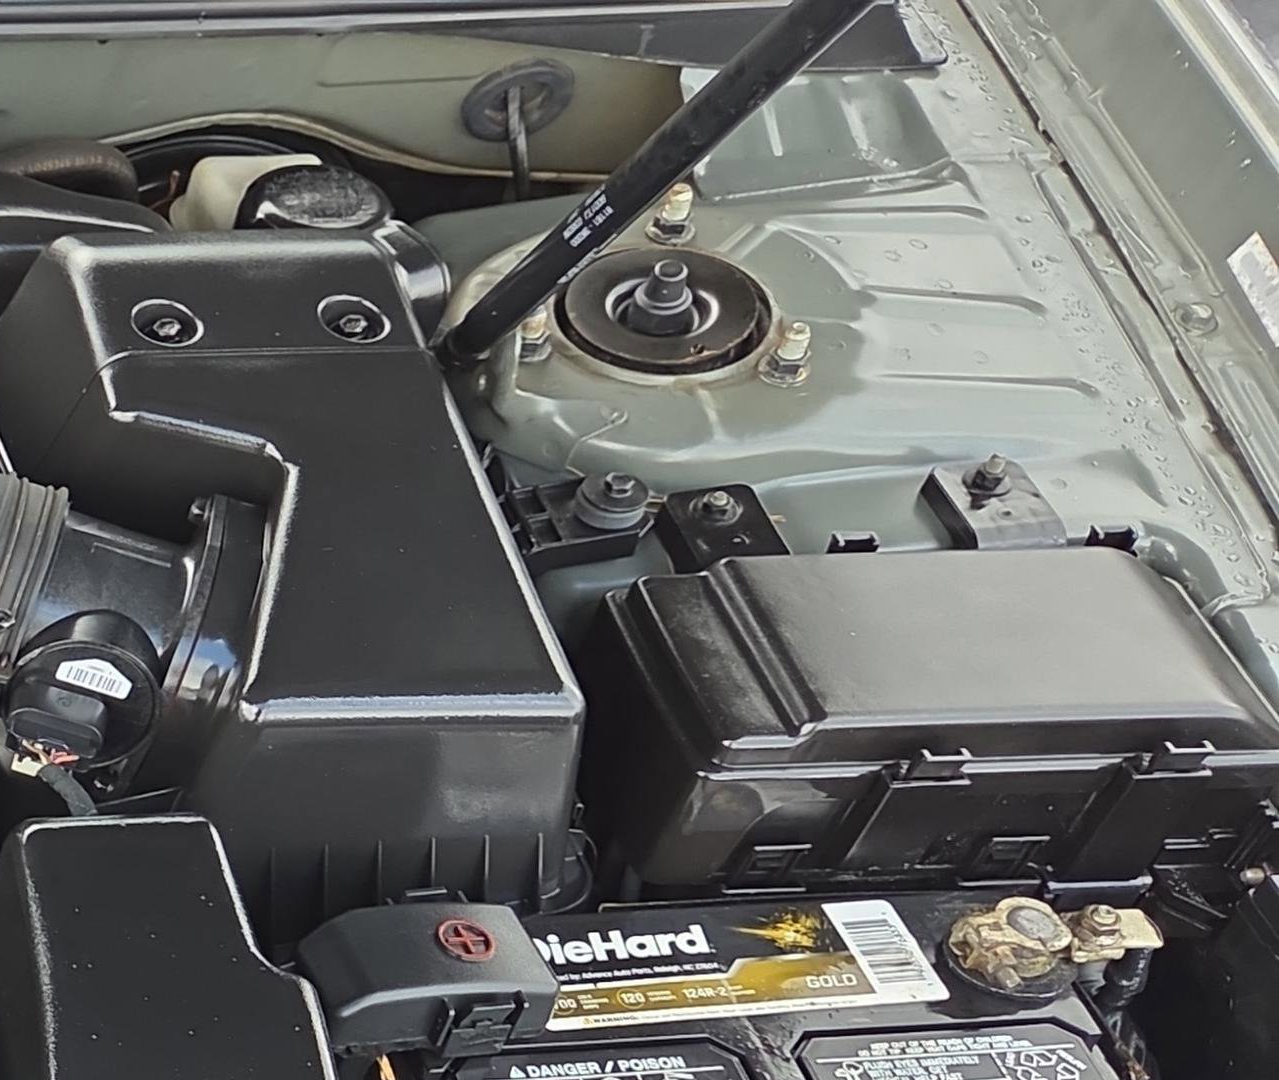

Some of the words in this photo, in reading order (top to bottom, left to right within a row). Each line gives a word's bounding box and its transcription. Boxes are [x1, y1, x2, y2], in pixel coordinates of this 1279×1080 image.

[804, 973, 858, 990] GOLD
[620, 992, 646, 1004] 120
[682, 986, 728, 999] 124R-2
[526, 1061, 602, 1078] DANGER
[617, 1056, 687, 1072] POISON
